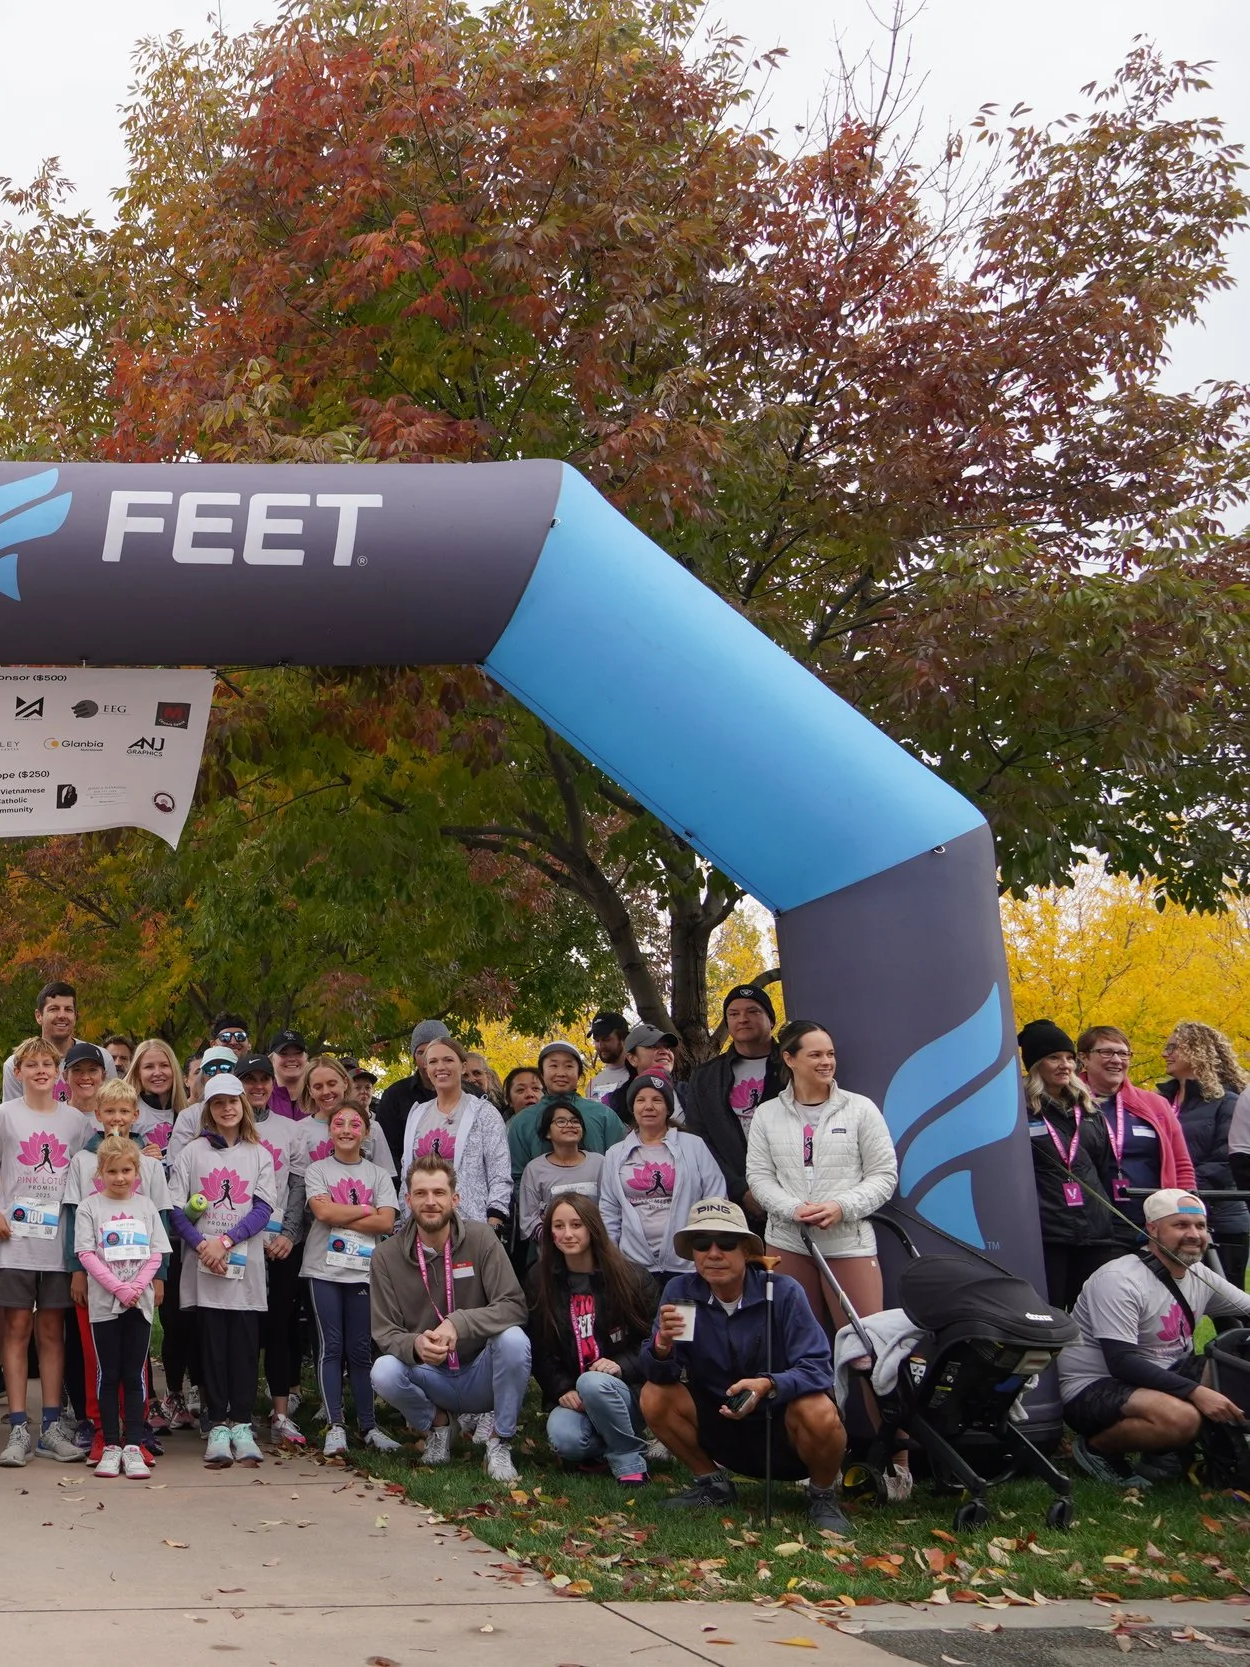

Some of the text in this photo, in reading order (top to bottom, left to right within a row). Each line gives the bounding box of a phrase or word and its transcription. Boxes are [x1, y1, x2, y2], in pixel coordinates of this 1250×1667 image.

[102, 490, 383, 567] FEET
[103, 704, 127, 713] EEG
[61, 739, 104, 748] Glanbia
[126, 749, 163, 757] GRAPHICS
[18, 770, 50, 779] ($250)
[0, 787, 46, 796] Vietnamese
[17, 1176, 67, 1186] PINK LOTUS
[697, 1204, 731, 1215] PING
[27, 1209, 45, 1225] 100
[121, 1231, 135, 1245] 77
[345, 1241, 360, 1255] 52
